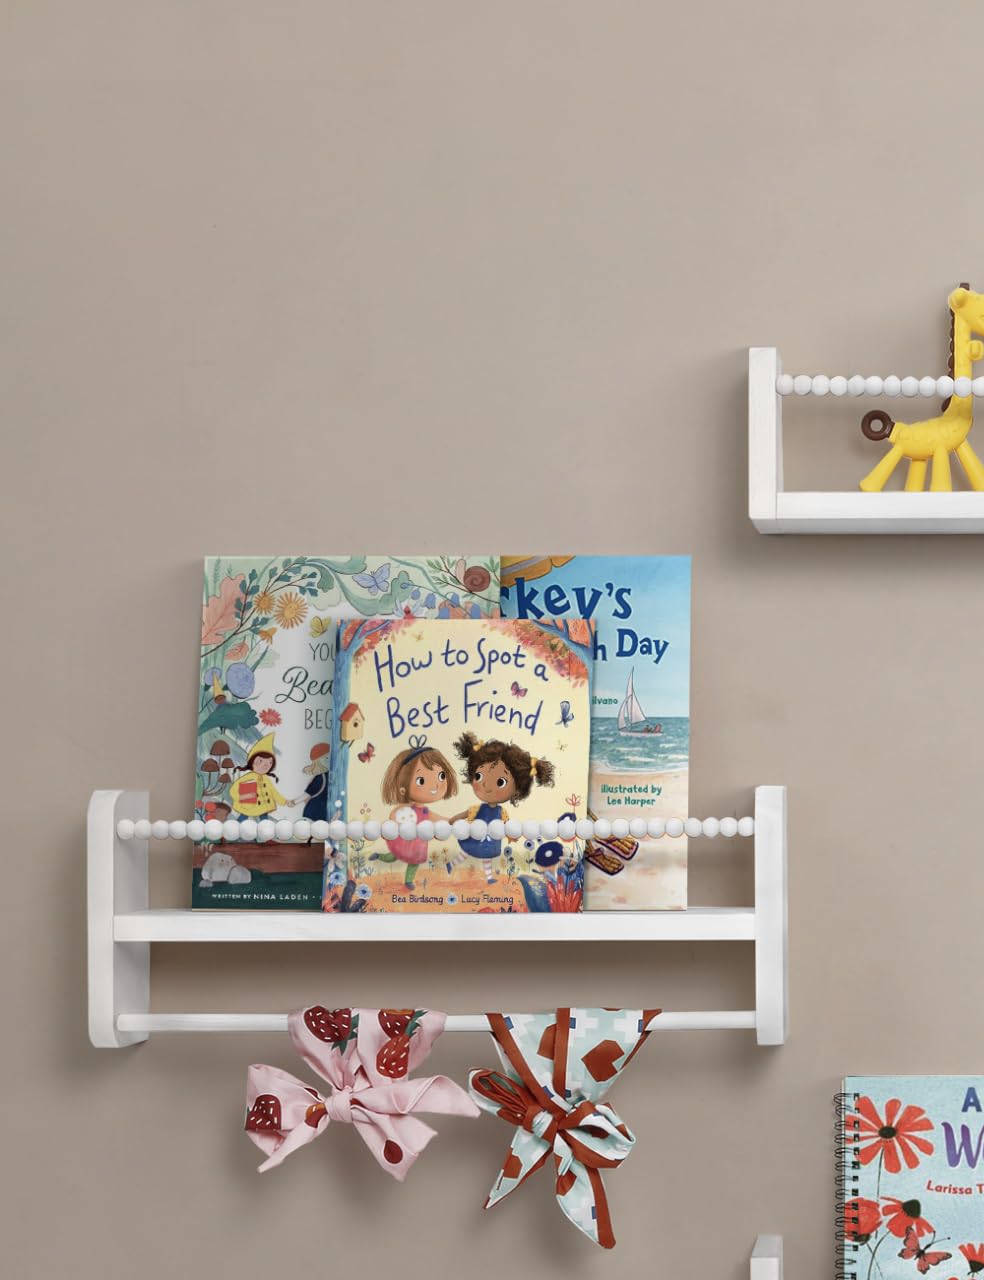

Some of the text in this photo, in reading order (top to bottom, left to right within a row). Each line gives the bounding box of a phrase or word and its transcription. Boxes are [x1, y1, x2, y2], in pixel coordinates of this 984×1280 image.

[616, 628, 669, 664] Day
[373, 637, 549, 692] How to Spot a
[386, 679, 543, 738] Best Friend
[651, 784, 662, 796] by
[607, 796, 656, 807] Lee Harper
[391, 894, 444, 905] Bea Birdsong
[461, 894, 514, 905] Lucy Fleming
[961, 1086, 982, 1113] A
[926, 1180, 972, 1195] Larissa
